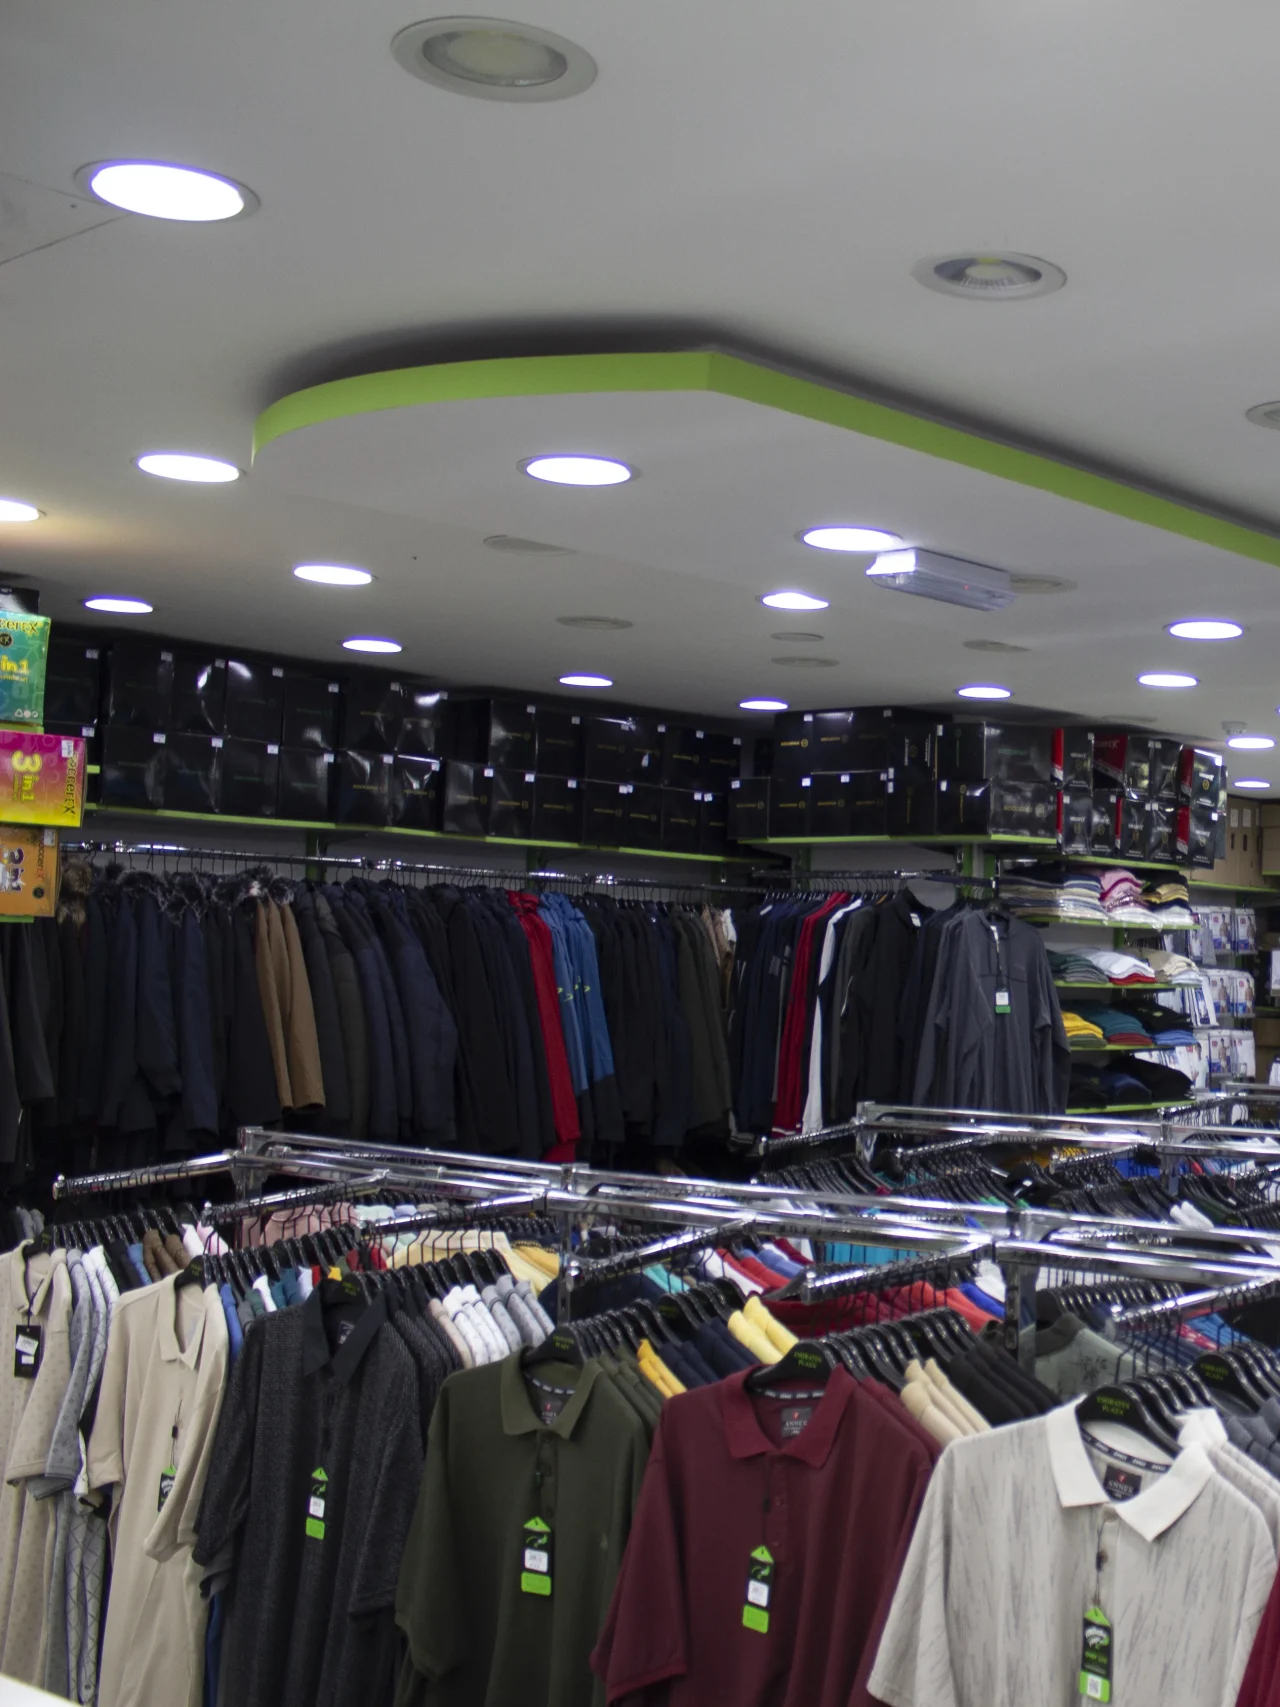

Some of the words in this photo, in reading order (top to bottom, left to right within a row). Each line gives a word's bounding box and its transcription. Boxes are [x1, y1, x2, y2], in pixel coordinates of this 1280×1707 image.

[11, 750, 42, 773] 3
[22, 774, 39, 791] in
[1108, 1480, 1135, 1494] ANNEX
